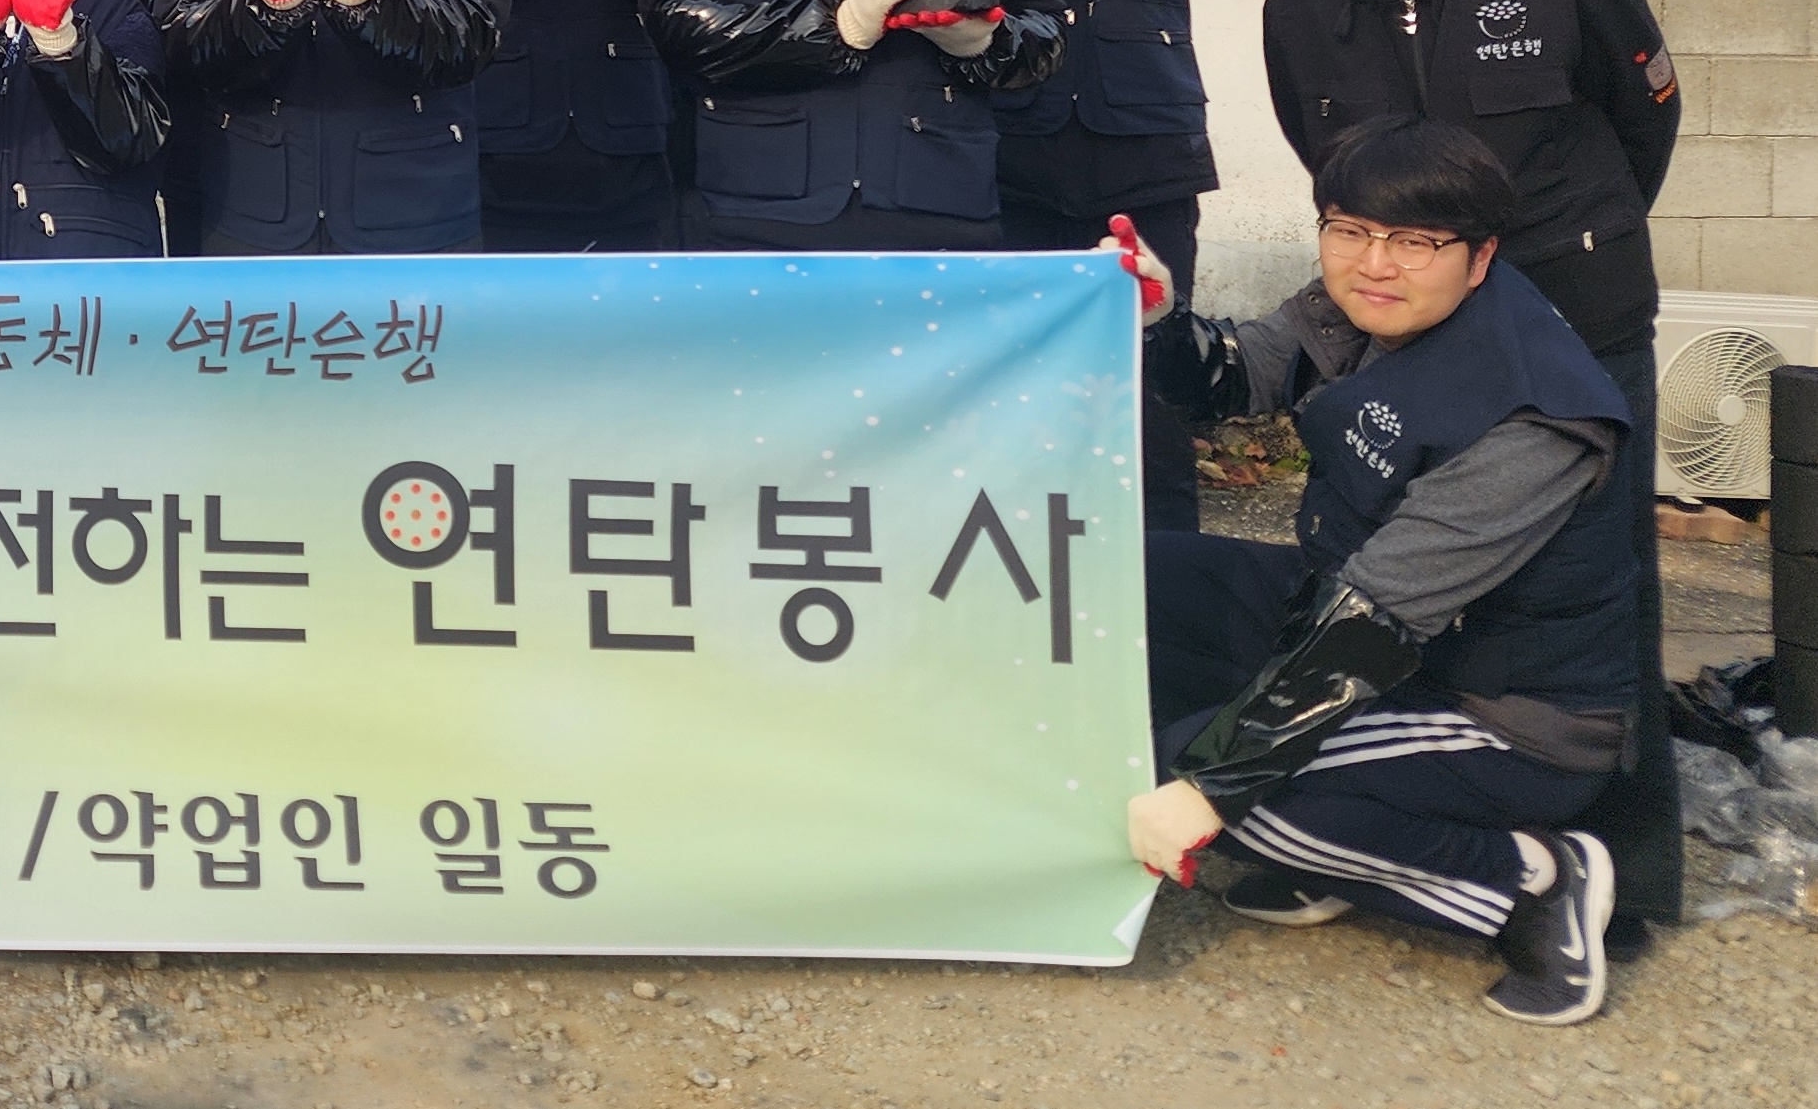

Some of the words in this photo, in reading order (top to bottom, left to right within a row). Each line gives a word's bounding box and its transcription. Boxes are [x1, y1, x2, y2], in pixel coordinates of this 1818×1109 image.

[1476, 38, 1542, 60] 연탄은행
[165, 299, 444, 383] 연탄은행
[362, 460, 1085, 664] 연탄봉사
[419, 796, 611, 900] 일동
